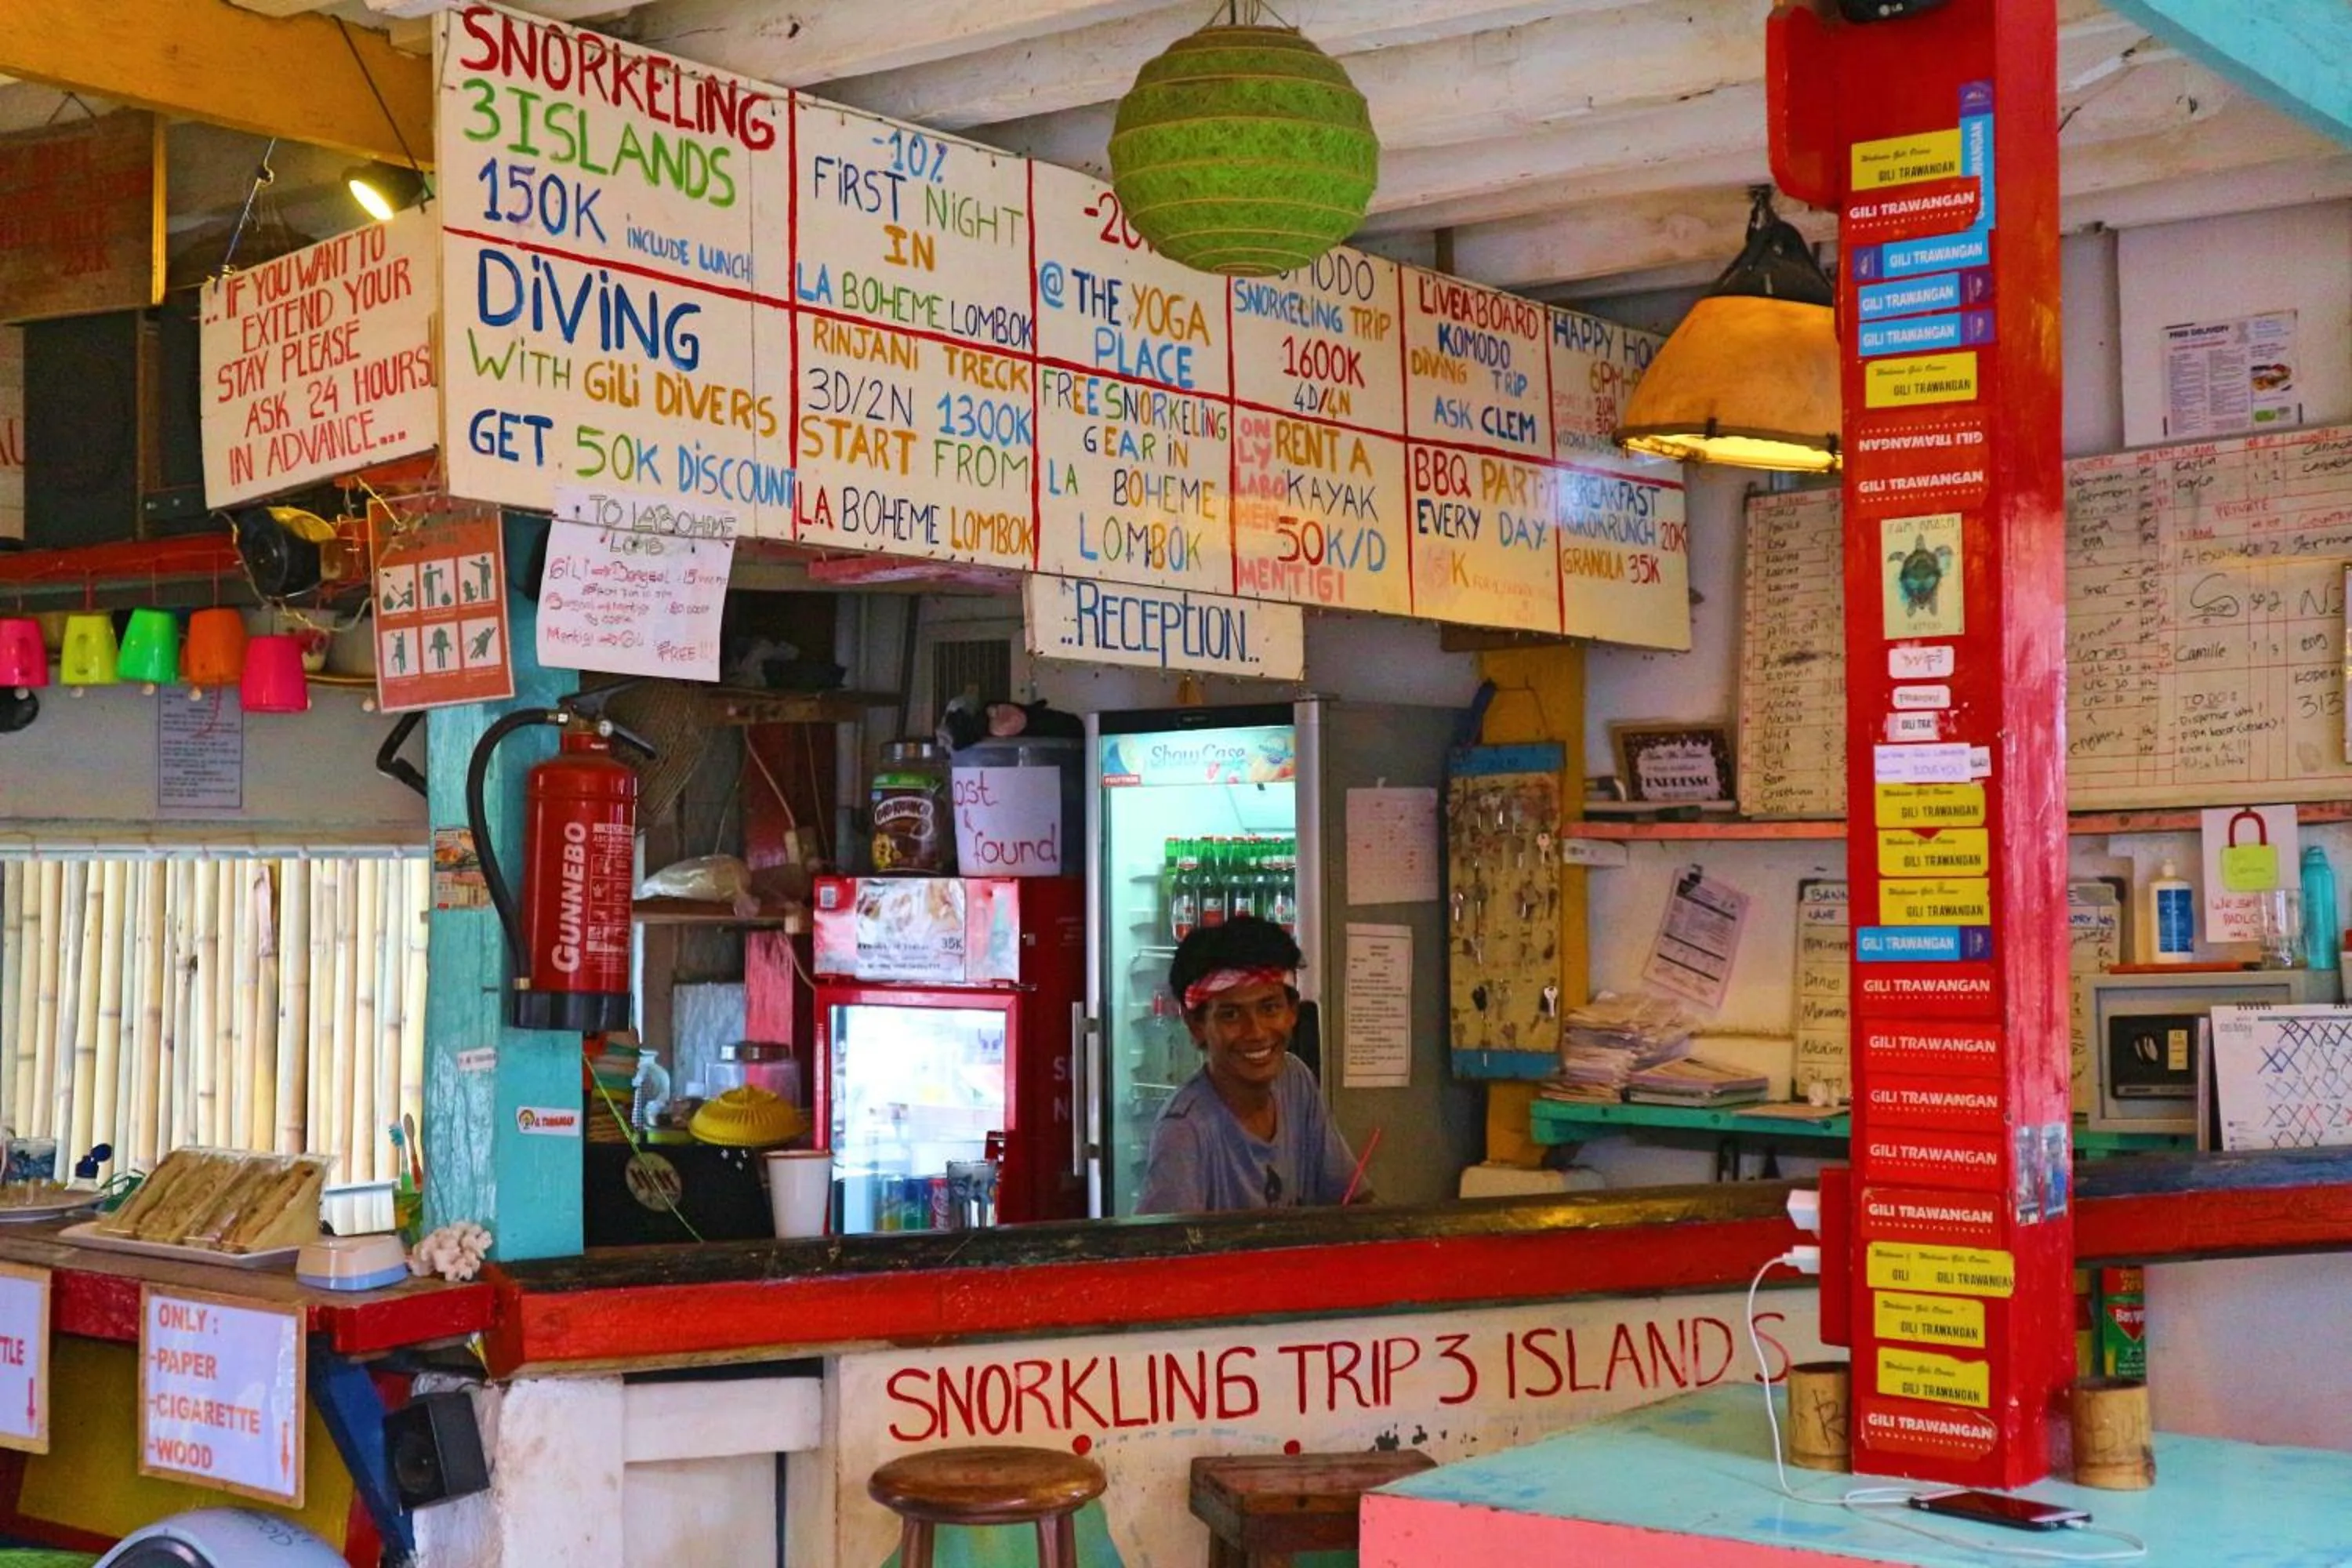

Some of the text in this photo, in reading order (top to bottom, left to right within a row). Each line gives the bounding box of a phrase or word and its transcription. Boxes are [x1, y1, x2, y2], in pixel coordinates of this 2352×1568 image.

[463, 78, 735, 207] 3 ISLANDS
[478, 158, 606, 244] 150K
[1849, 205, 1877, 219] GILI
[1881, 191, 1975, 215] TRAWANGAN
[252, 257, 292, 306] YOU
[296, 235, 353, 293] WANT
[353, 225, 386, 269] TO
[699, 245, 753, 287] LUNCH
[884, 224, 935, 272] IN
[1889, 241, 1983, 268] GILI TRAWANGAN
[242, 257, 412, 353] EXTEND YOUR
[797, 262, 1033, 350] LA BOHEME LOMBOK
[1040, 261, 1211, 347] @ THE YOGA
[1862, 285, 1954, 311] GILI TRAWANGAN
[1094, 327, 1195, 389] PLACE
[1439, 322, 1510, 369] KOMODO
[1553, 311, 1613, 358] HAPPY
[1863, 324, 1955, 347] GILI TRAWANGAN
[218, 319, 361, 404] STAY PLEASE
[942, 345, 1029, 394] TRECK
[1282, 336, 1365, 389] 1600K
[245, 344, 432, 437] ASK 24 HOURS
[808, 368, 1032, 446] 3D/2N 1300K
[1042, 369, 1100, 416] FREE
[1083, 425, 1156, 463] GEAR
[1435, 396, 1474, 430] ASK
[1482, 405, 1536, 445] CLEM
[229, 442, 253, 485] IN
[469, 408, 554, 466] GET
[575, 425, 661, 485] 50K
[800, 415, 1029, 492] START FROM
[1276, 419, 1372, 477] RENT A
[1049, 458, 1216, 520] LA BOHEME
[1287, 468, 1378, 523] KAYAK
[1414, 447, 1471, 497] BBQ
[1859, 470, 1983, 492] GILI TRAWANGAN
[798, 481, 1034, 556] LA BOHEME LOMBOK
[1080, 512, 1203, 572] LOMBOK
[1417, 499, 1481, 541] EVERY
[1276, 515, 1386, 572] 50K/D
[1563, 548, 1660, 584] GRANOLA 35K
[953, 771, 998, 808] ost
[974, 824, 1057, 867] found
[551, 822, 586, 973] GUNNEBO
[1862, 937, 1955, 951] GILI TRAWANGAN
[1864, 979, 1991, 993] GILI TRAWANGAN
[1869, 1036, 1996, 1053] GILI TRAWANGAN
[1871, 1090, 1998, 1108] GILI TRAWANGAN
[1870, 1144, 1997, 1165] GILI TRAWANGAN
[1868, 1203, 1994, 1224] GILI TRAWANGAN
[0, 1336, 25, 1367] TLE
[1279, 1338, 1420, 1414] TRIP
[1436, 1333, 1479, 1404] 3
[1507, 1312, 1791, 1399] ISLANDS
[1868, 1414, 1993, 1439] GILI TRAWANGAN
